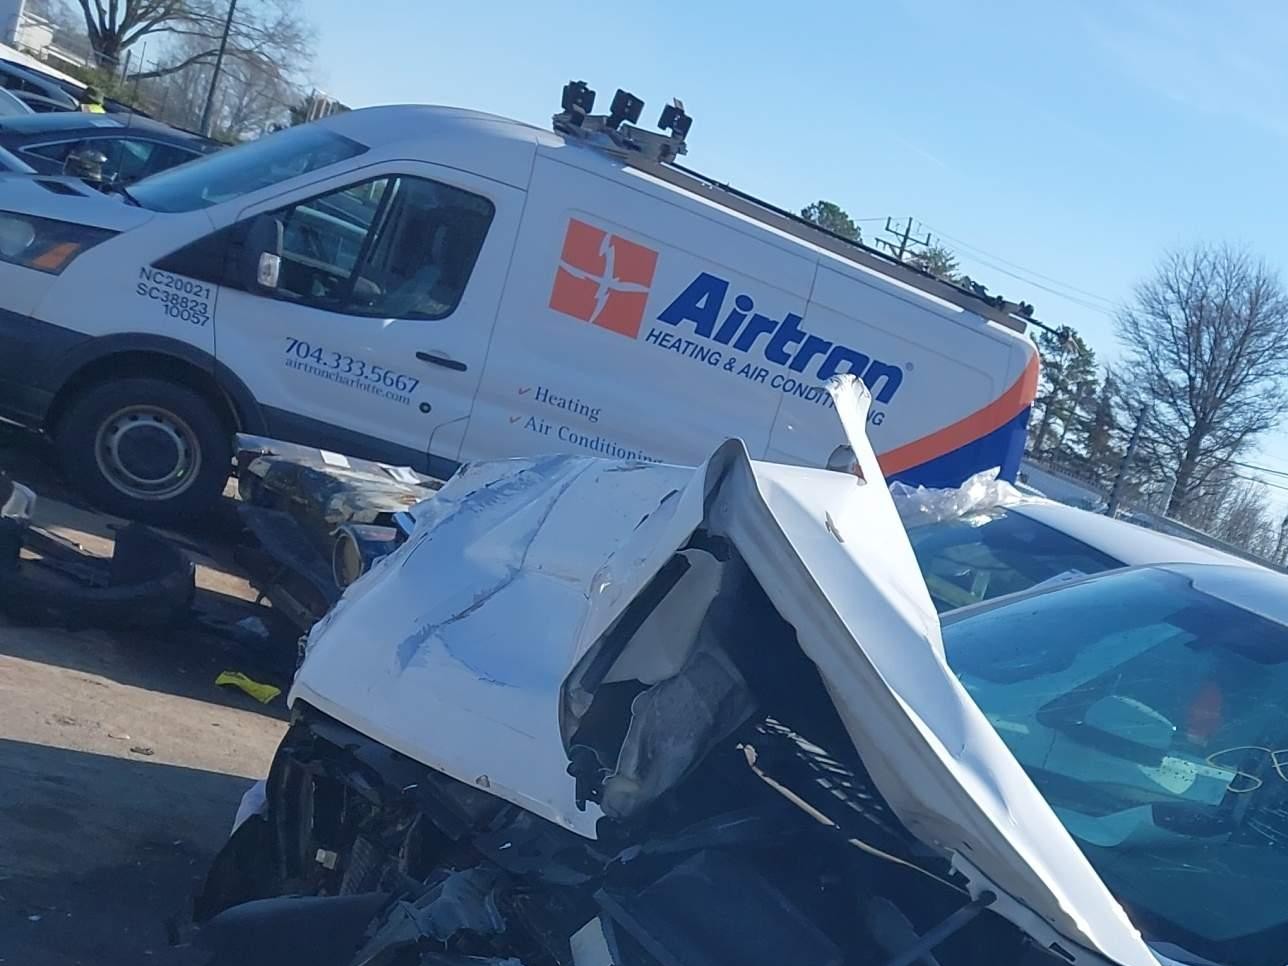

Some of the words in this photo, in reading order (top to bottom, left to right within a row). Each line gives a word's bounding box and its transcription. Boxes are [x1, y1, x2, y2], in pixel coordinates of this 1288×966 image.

[136, 282, 208, 315] SC38823
[139, 267, 210, 299] NC20021
[163, 304, 210, 326] 10057
[645, 328, 722, 367] HEATING
[723, 357, 737, 373] &
[737, 363, 769, 384] AIR
[656, 272, 904, 405] Airtron
[285, 358, 411, 405] airtroncharlotte.com
[286, 336, 420, 394] 704.333.5667
[535, 386, 602, 422] Heating
[524, 416, 553, 436] Air
